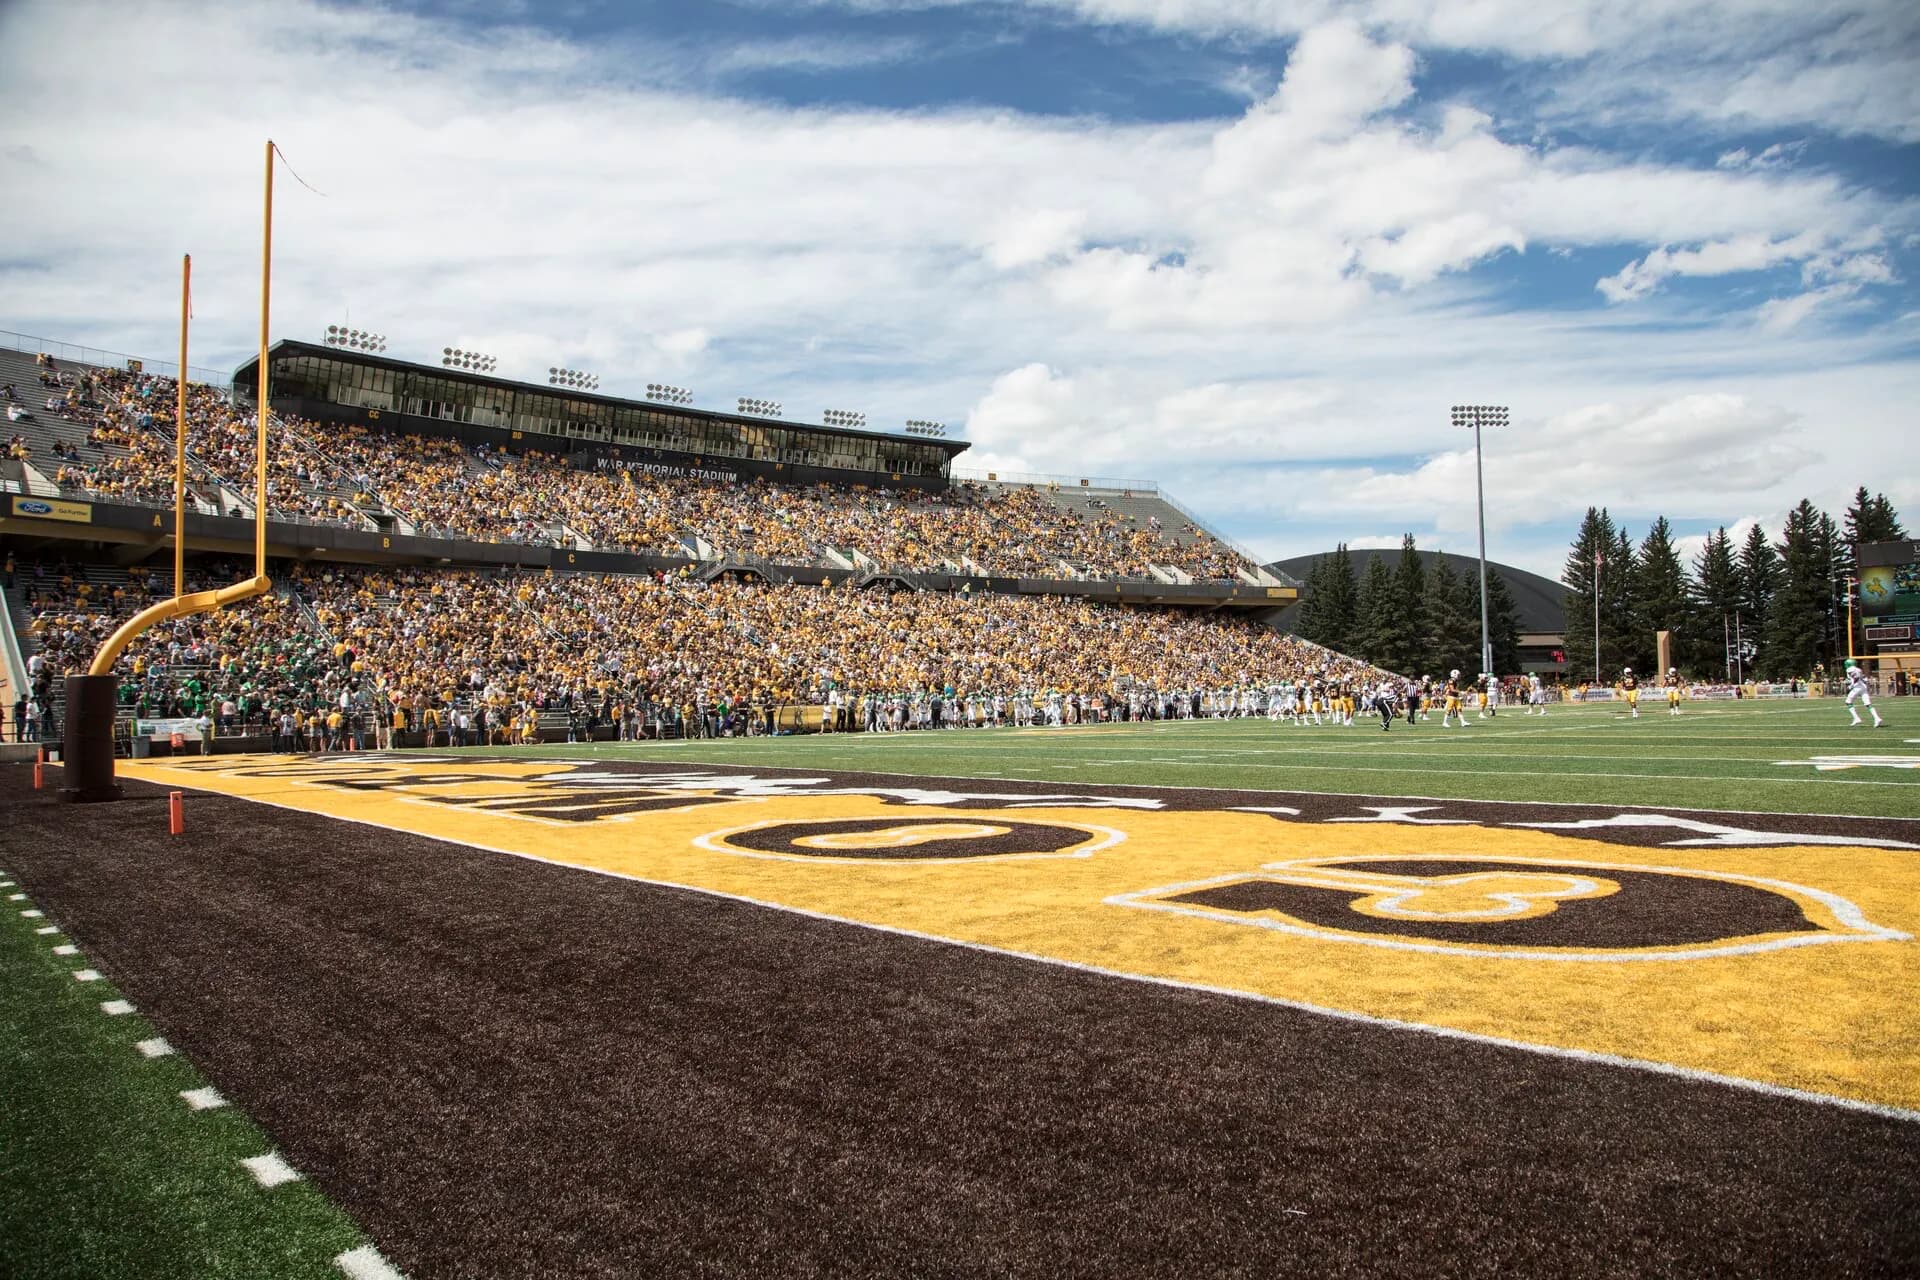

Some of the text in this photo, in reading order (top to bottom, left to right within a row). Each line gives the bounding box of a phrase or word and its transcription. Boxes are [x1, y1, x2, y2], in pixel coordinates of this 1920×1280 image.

[597, 458, 624, 469] WAR
[689, 468, 737, 483] STADIUM
[153, 514, 162, 527] A
[383, 537, 390, 548] B
[568, 553, 575, 563] C
